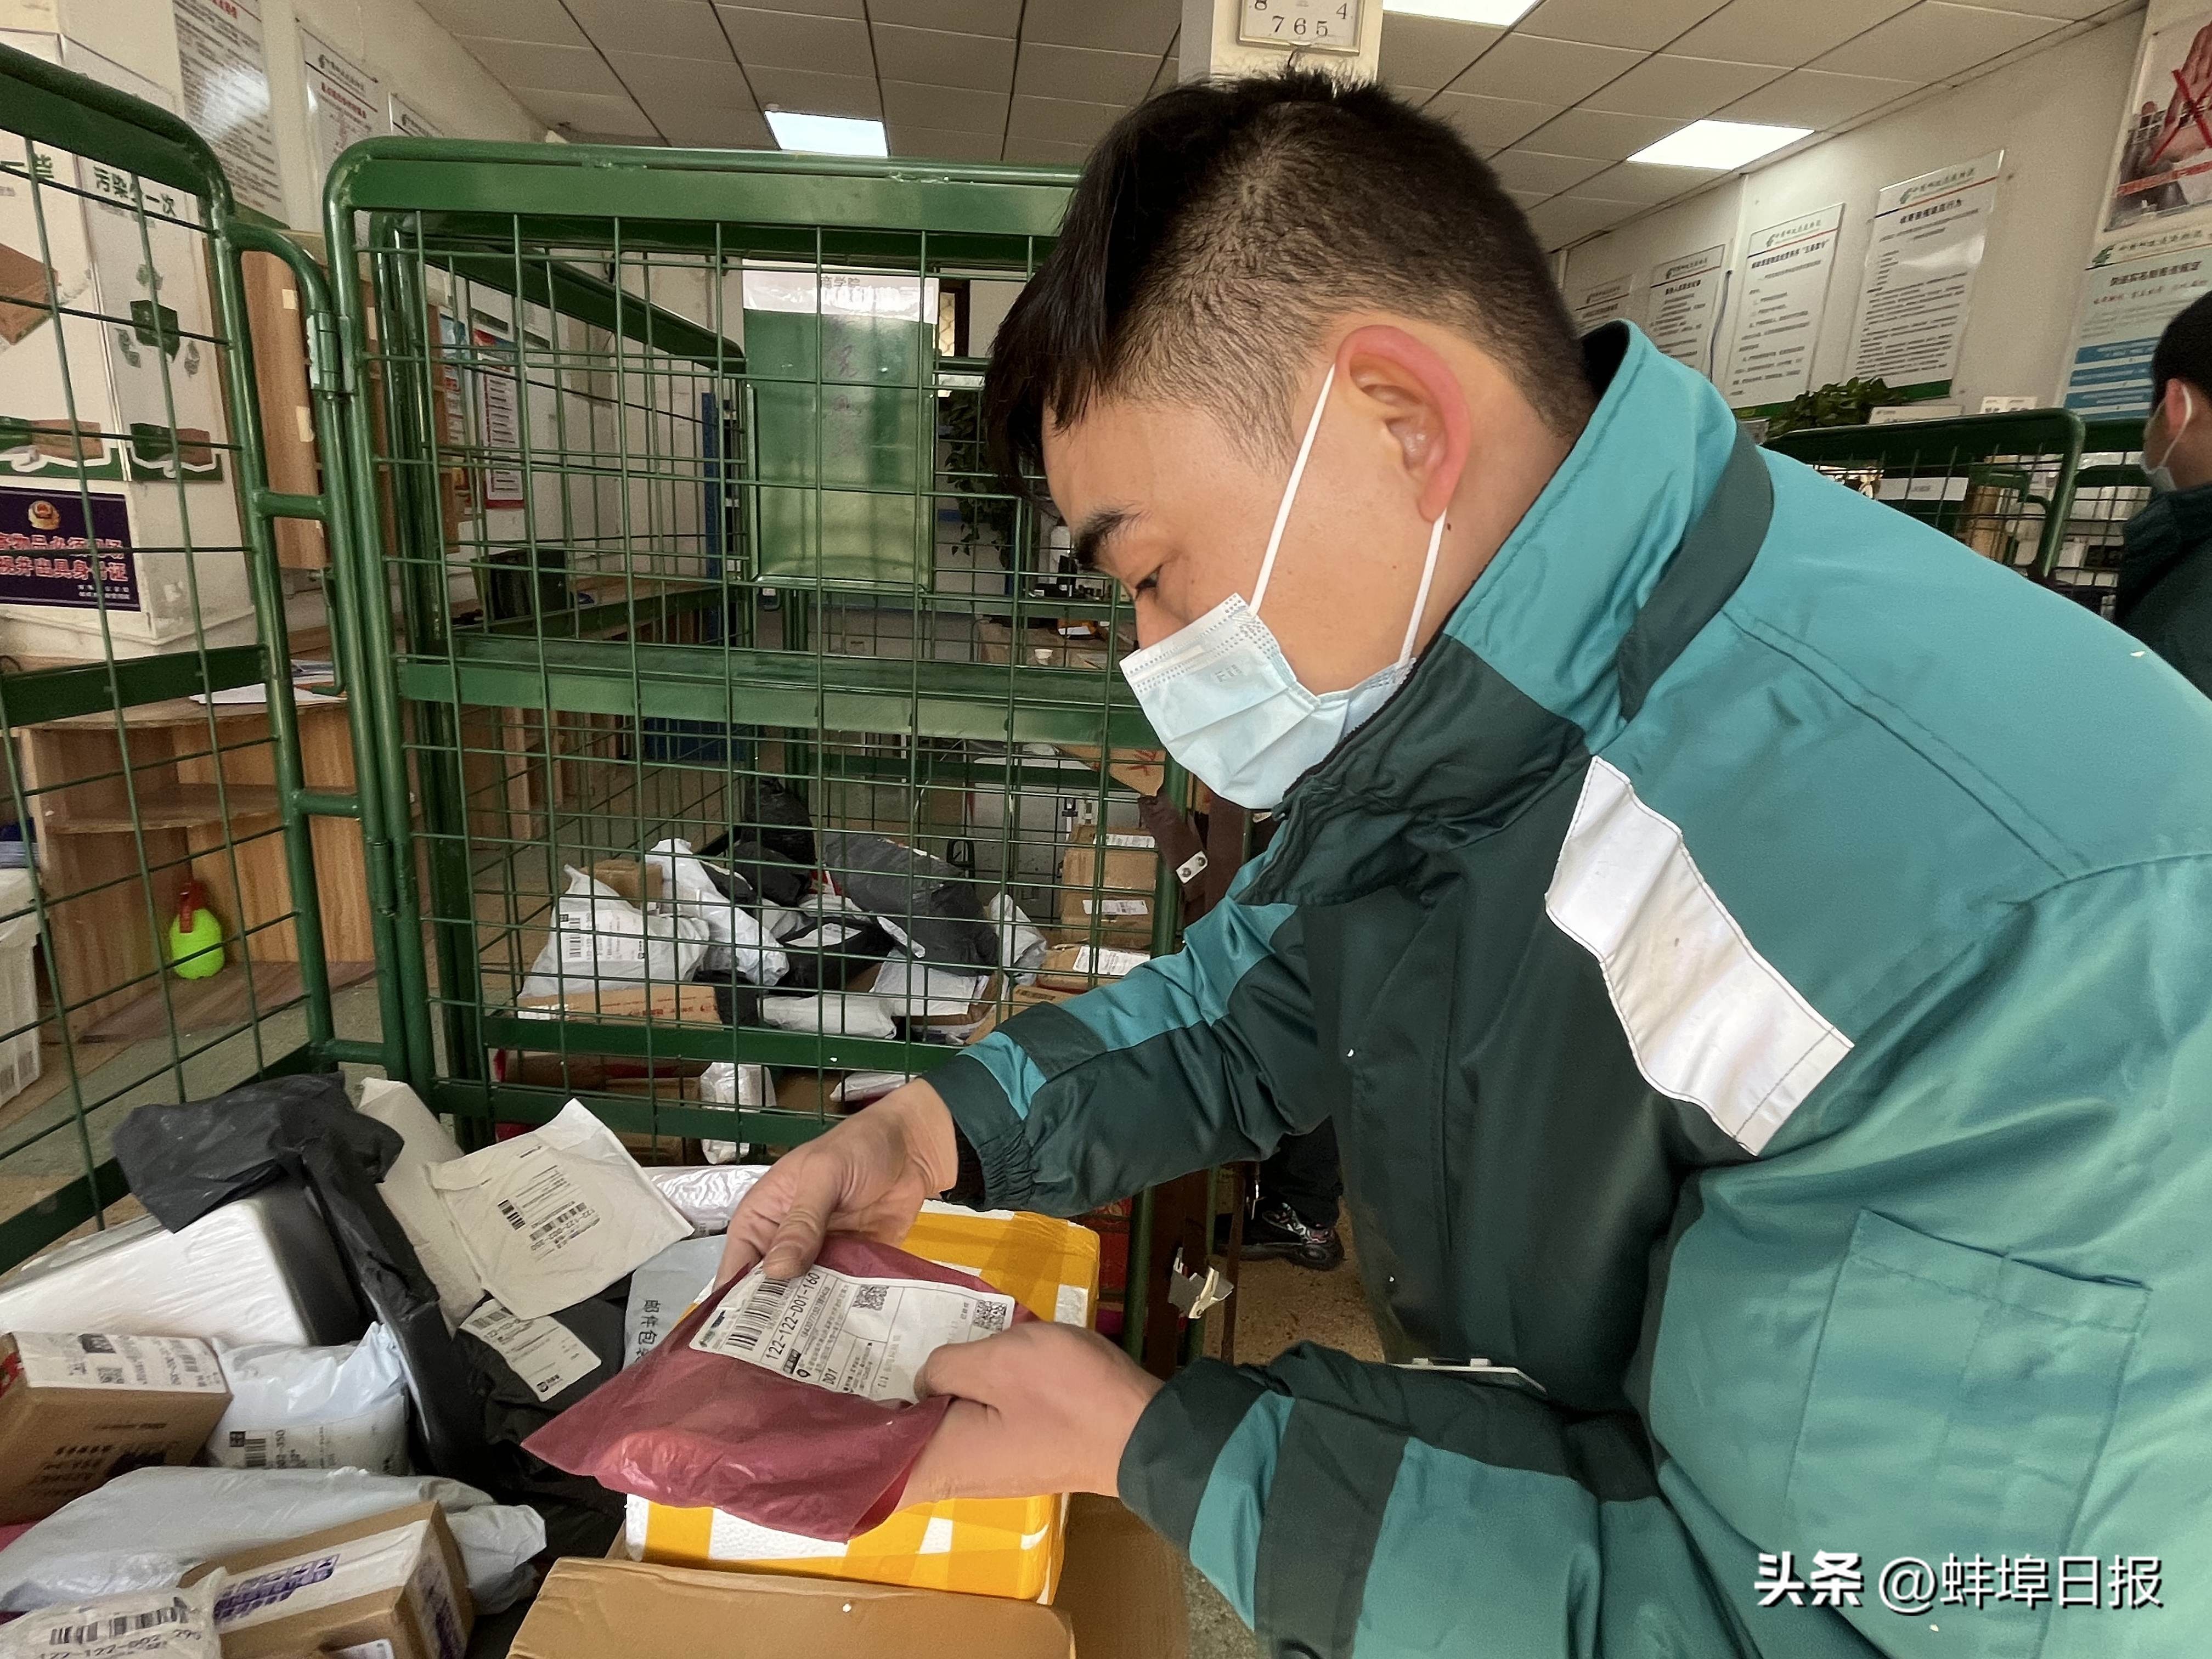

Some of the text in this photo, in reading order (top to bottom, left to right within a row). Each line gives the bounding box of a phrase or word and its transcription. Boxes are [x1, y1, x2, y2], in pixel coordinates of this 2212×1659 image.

[1336, 2, 1347, 20] 4
[1272, 15, 1285, 33] 7
[1294, 18, 1306, 35] 6
[1316, 20, 1328, 37] 5
[765, 1272, 822, 1362] 122-122-D01-160
[823, 1367, 839, 1387] D01
